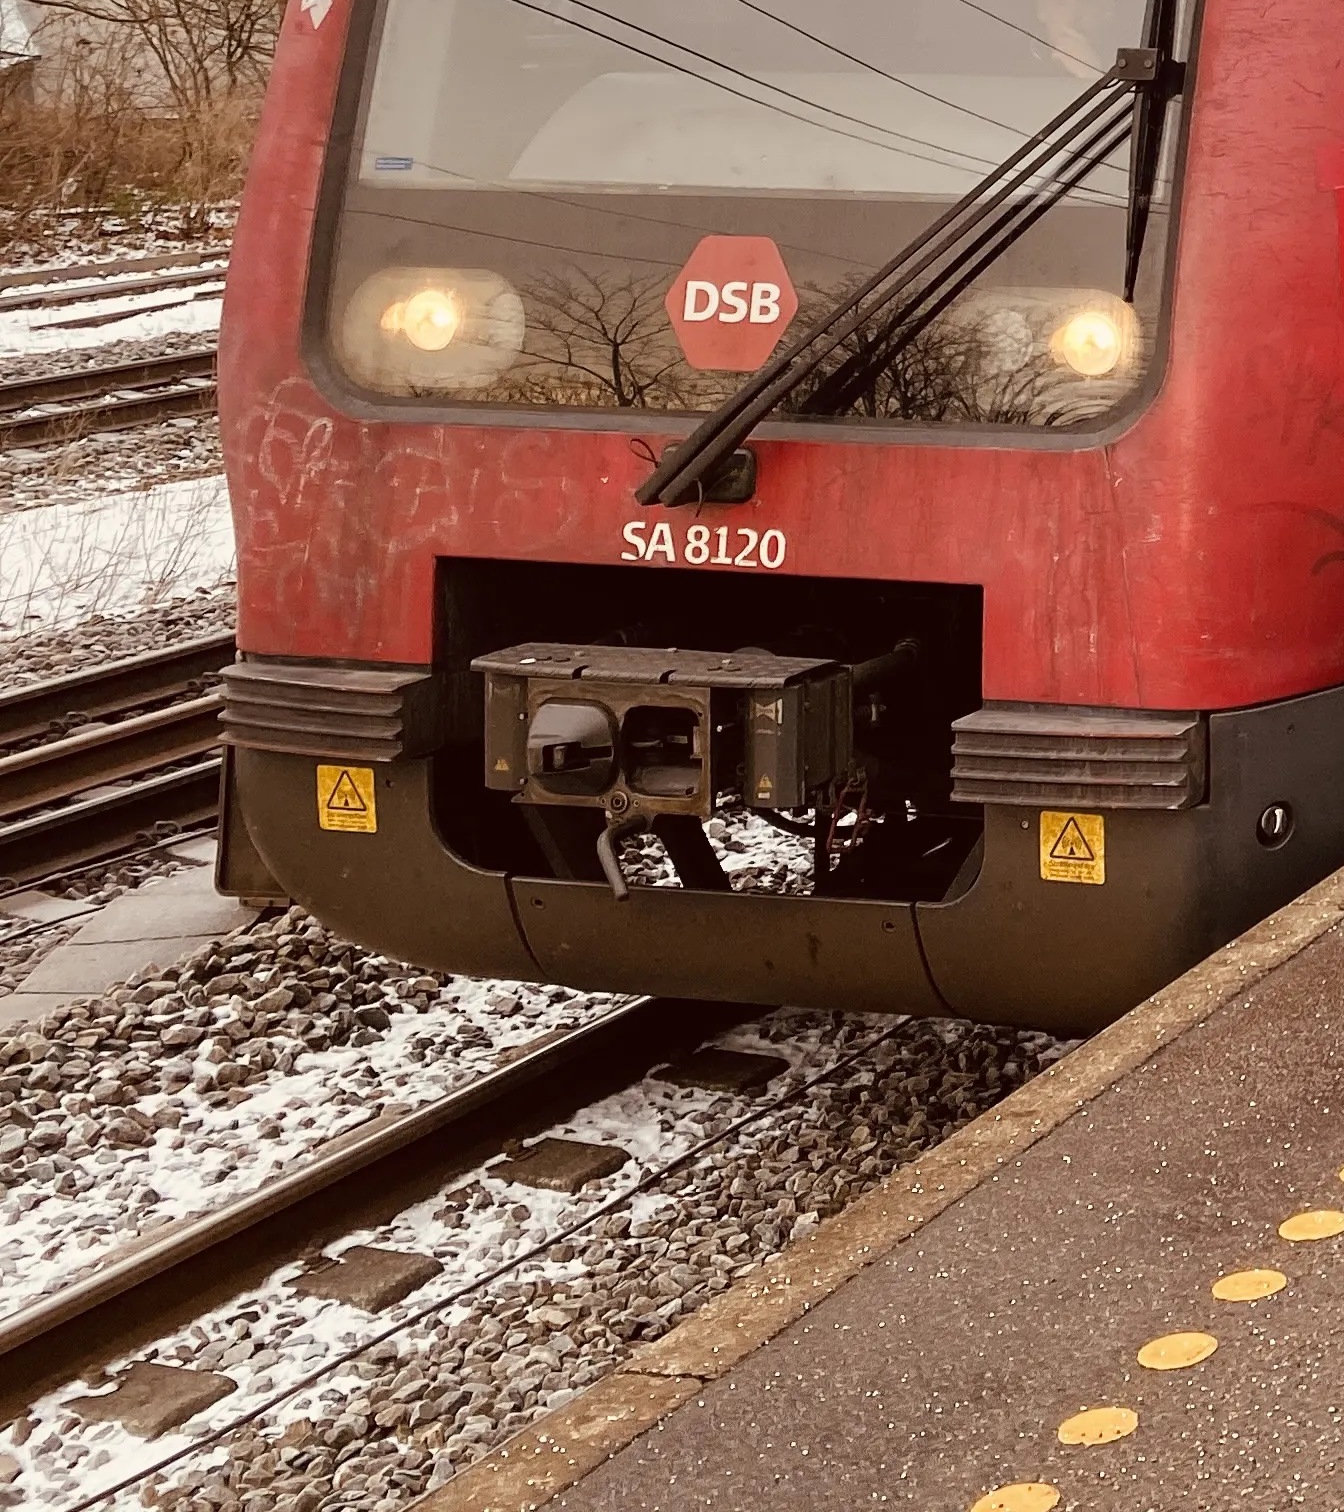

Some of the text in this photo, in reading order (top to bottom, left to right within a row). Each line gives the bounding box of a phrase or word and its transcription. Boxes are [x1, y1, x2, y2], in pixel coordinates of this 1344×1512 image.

[683, 280, 781, 324] DSB
[621, 521, 787, 569] SA 8120
